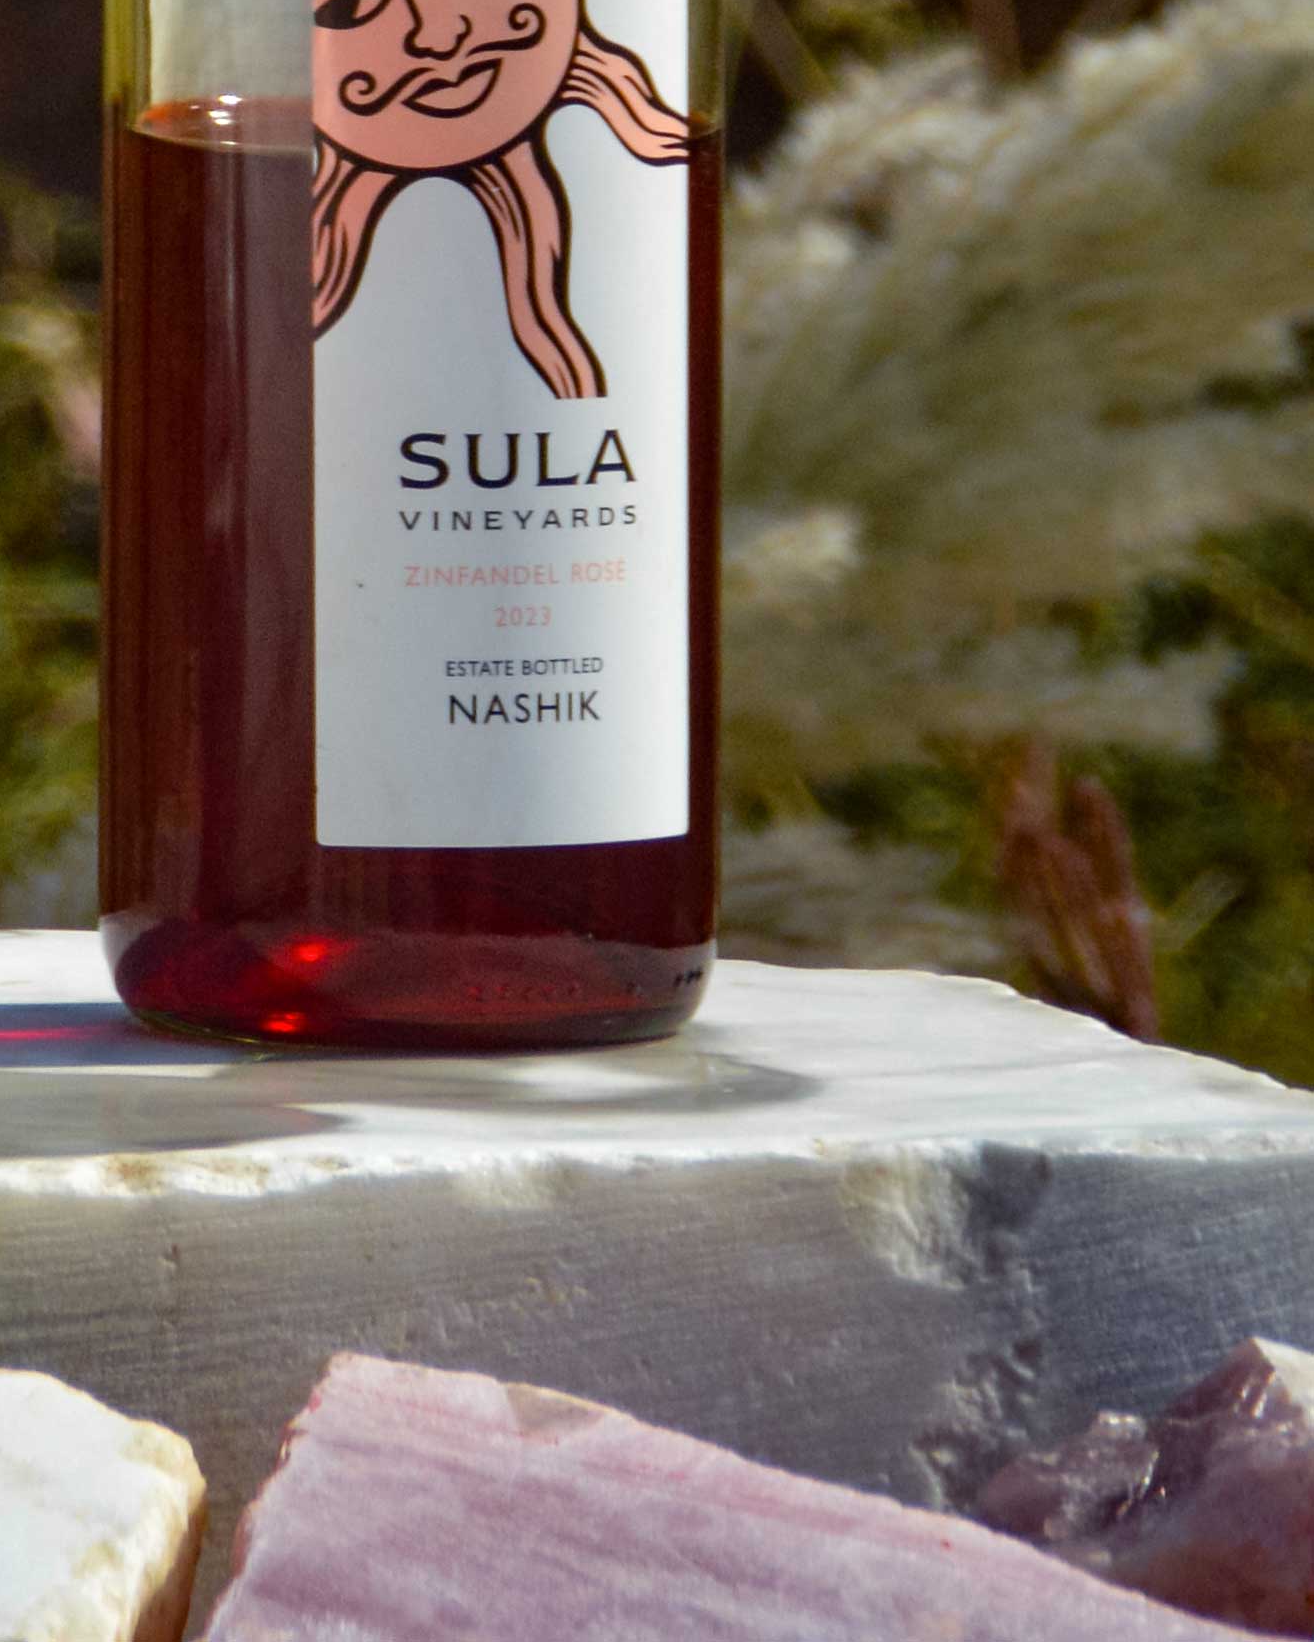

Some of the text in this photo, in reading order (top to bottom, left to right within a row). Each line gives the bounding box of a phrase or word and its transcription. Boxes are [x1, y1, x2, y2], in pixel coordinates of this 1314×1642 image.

[399, 429, 637, 490] SULA
[398, 504, 637, 532] VINEYARDS
[403, 563, 560, 588] ZINFANDEL
[494, 605, 552, 628] 2023
[445, 656, 604, 678] ESTATE BOTTLED
[449, 690, 600, 724] NASHIK
